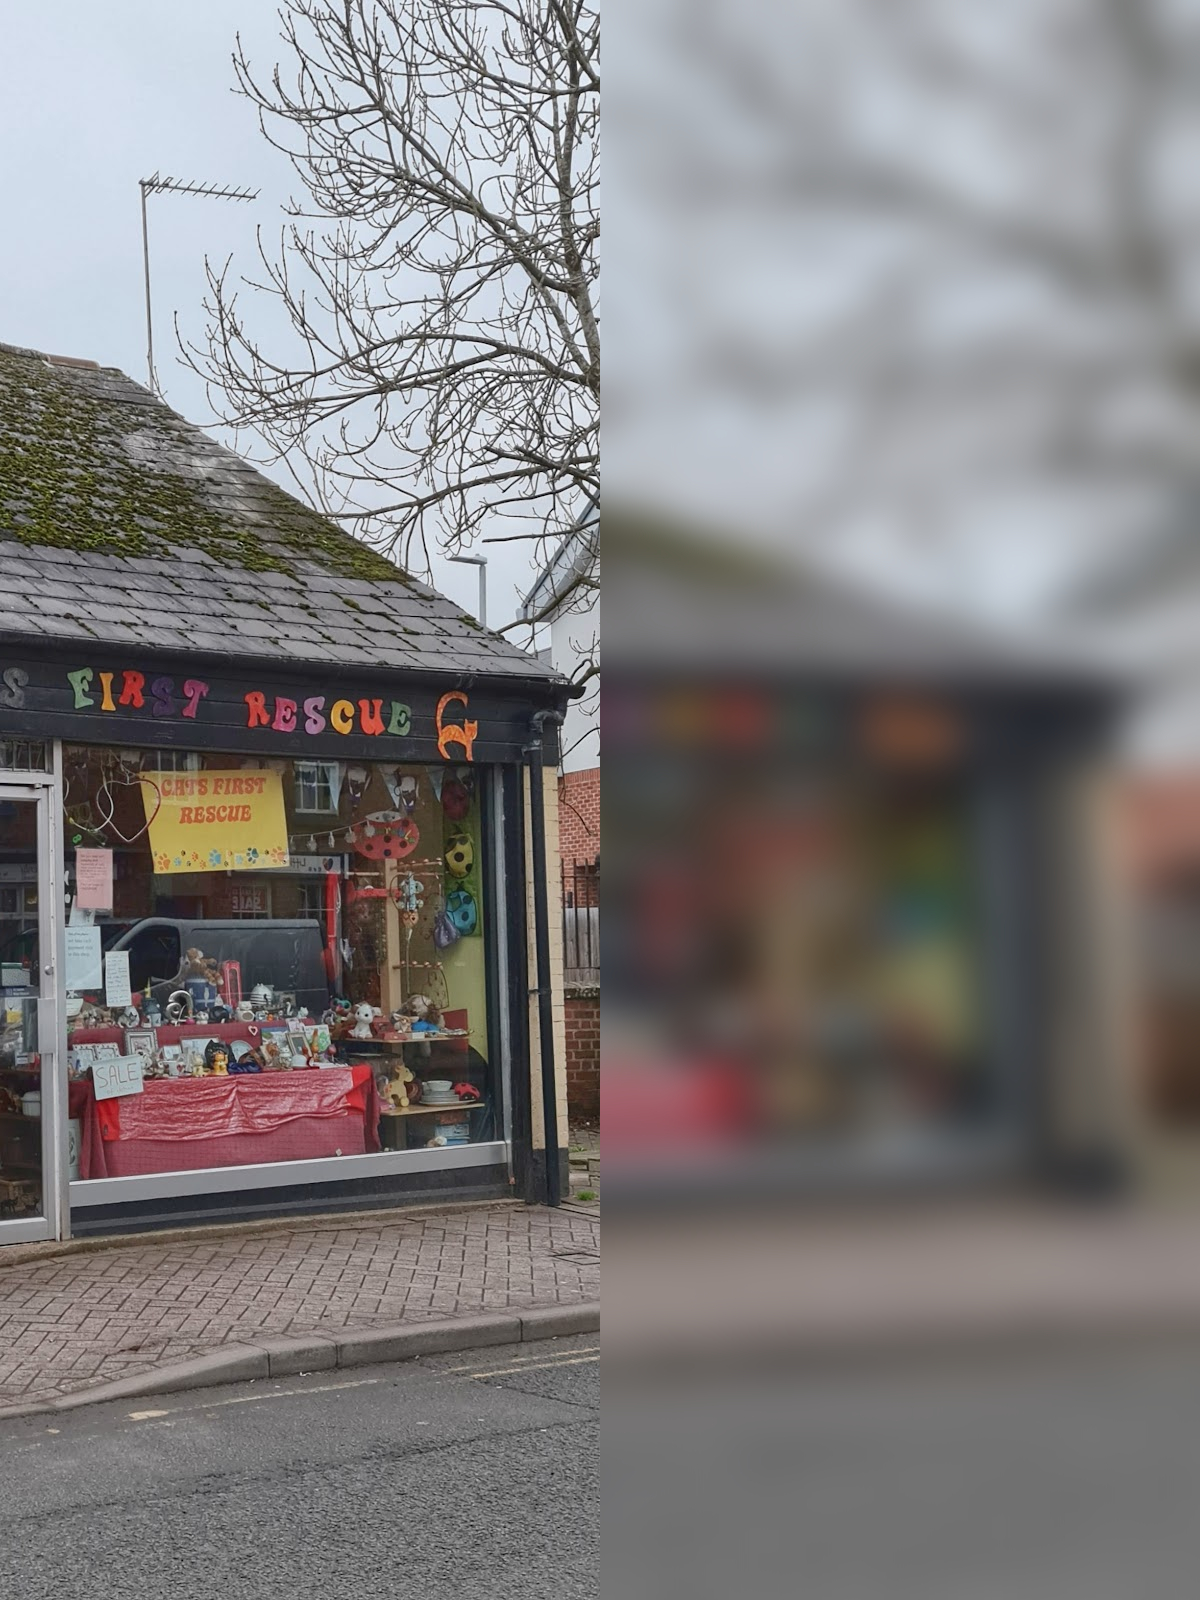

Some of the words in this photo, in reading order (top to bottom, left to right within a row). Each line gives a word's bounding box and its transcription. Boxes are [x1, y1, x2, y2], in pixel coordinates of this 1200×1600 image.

[67, 667, 209, 718] FIRST
[245, 691, 411, 736] RESCUE
[161, 778, 208, 797] CATS
[212, 777, 266, 795] FIRST
[179, 805, 251, 824] RESCUE
[96, 1063, 139, 1088] SALE
